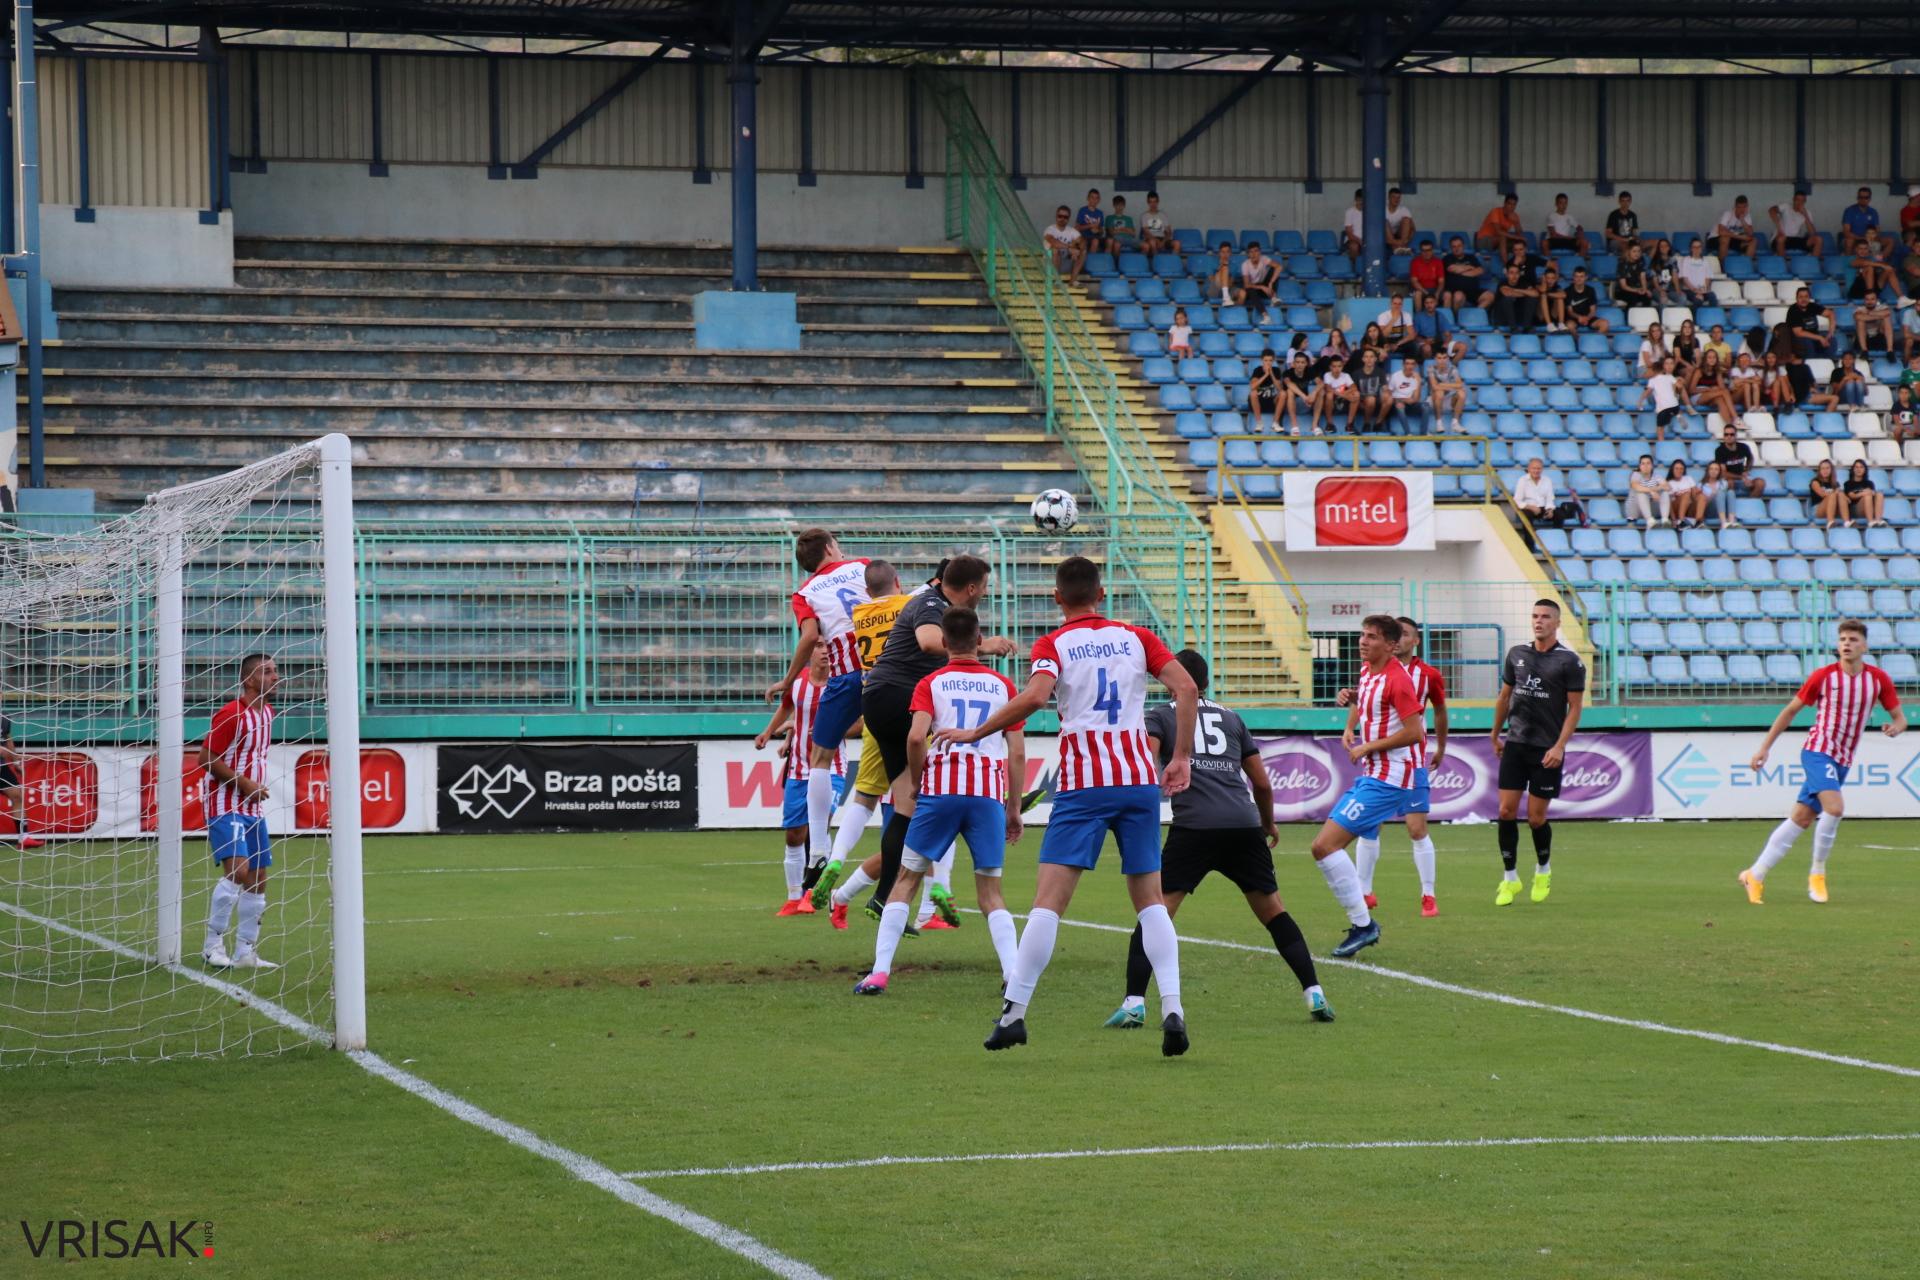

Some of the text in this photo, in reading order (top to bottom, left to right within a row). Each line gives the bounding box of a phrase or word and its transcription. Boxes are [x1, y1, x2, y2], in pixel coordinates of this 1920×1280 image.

[1325, 496, 1397, 524] m:tel
[856, 609, 901, 630] NEŠPOLJE
[1332, 604, 1361, 615] EXIT
[1068, 641, 1131, 661] KNEŠPOLJE
[942, 679, 1000, 695] KNEŠPOLJE
[1093, 668, 1121, 725] 4
[952, 699, 991, 748] 17
[1194, 712, 1228, 755] 15
[544, 768, 681, 798] Brza pošta
[545, 801, 586, 810] Hrvatska
[588, 800, 615, 811] pošta
[617, 801, 649, 810] Mostar
[1340, 799, 1365, 821] 16
